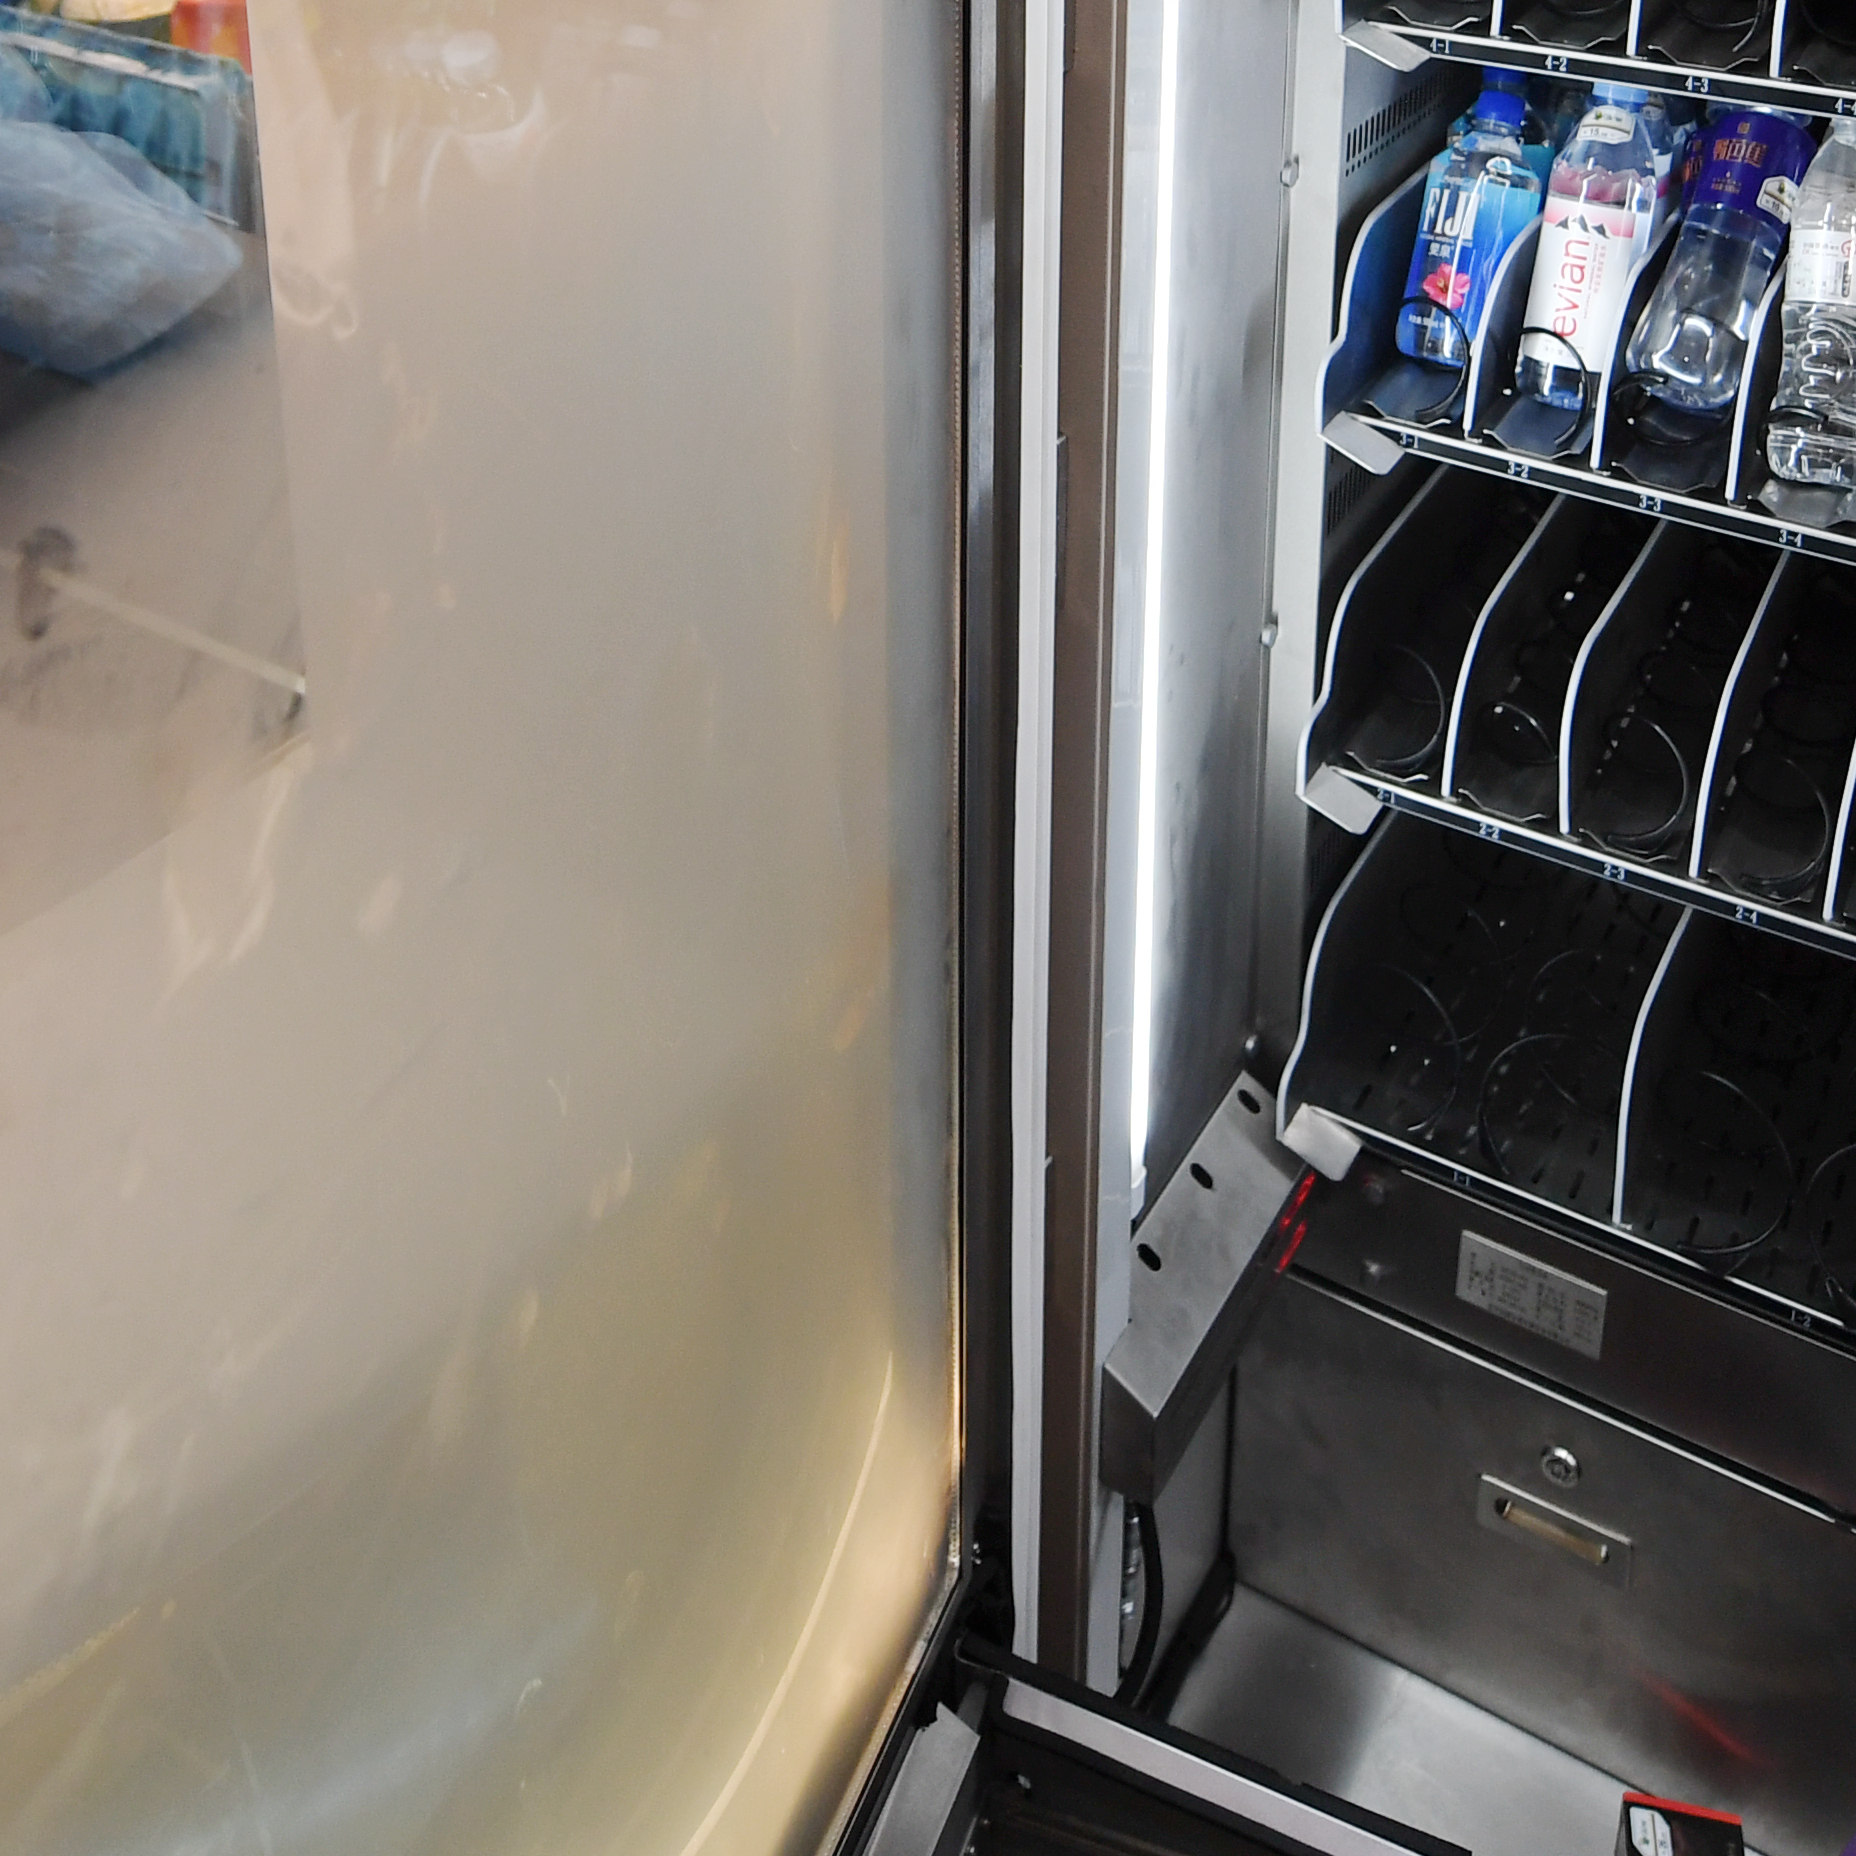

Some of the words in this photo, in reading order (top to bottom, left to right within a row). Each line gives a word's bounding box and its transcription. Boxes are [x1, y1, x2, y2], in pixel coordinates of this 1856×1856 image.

[1545, 56, 1567, 72] 4-2
[1685, 76, 1710, 93] 4-3
[1423, 187, 1480, 240] FIJI
[1553, 238, 1589, 338] evian
[1507, 461, 1529, 478] 3-2
[1639, 495, 1662, 512] 3-3
[1778, 528, 1803, 547] 3-4
[1479, 823, 1500, 840] 2-2
[1603, 863, 1626, 880] 2-3
[1736, 904, 1758, 924] 2-4
